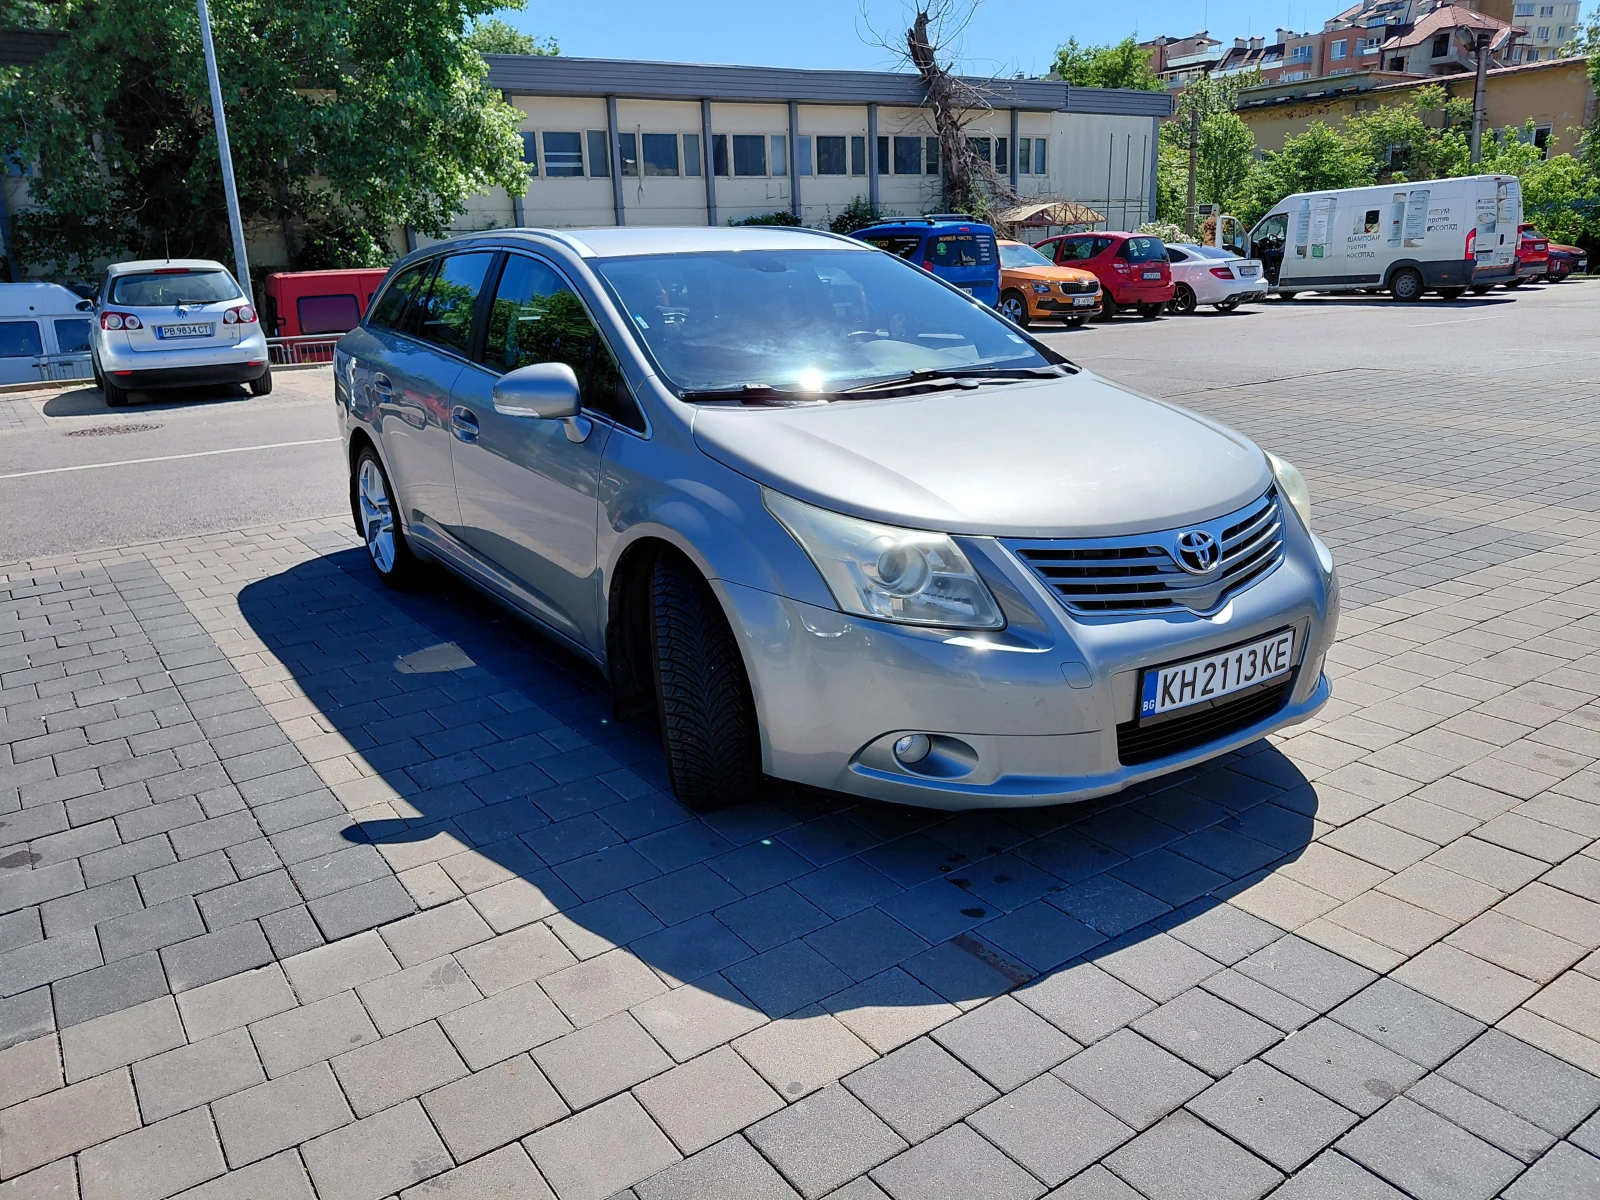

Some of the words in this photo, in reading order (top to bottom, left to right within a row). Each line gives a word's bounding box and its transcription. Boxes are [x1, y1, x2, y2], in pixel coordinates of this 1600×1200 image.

[1427, 224, 1458, 232] ОСОПАД
[1346, 251, 1375, 259] КОСОПАД
[1142, 700, 1155, 712] BG
